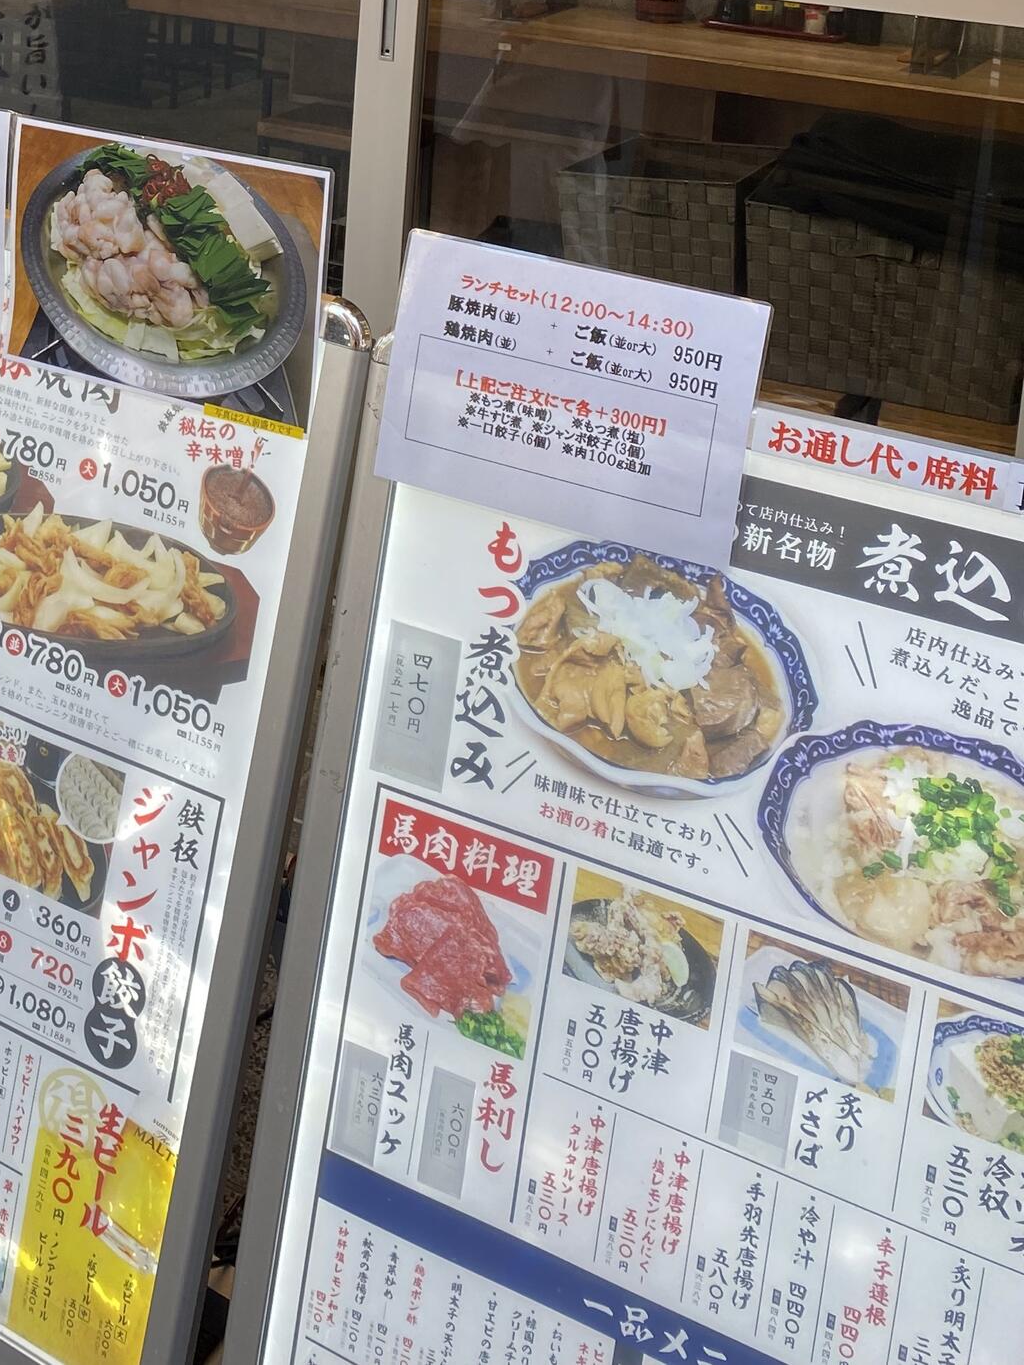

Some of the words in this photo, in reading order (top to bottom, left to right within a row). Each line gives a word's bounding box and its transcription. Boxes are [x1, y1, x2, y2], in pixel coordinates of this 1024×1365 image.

[444, 320, 517, 352] 鶏焼肉(並)
[570, 350, 653, 384] ご飯(並or大)
[669, 371, 718, 400] 950円
[447, 294, 521, 326] 豚焼肉(並)
[574, 324, 657, 357] ご飯(並or大)
[673, 345, 723, 372] 950円
[178, 417, 236, 440] 秘伝の
[465, 403, 522, 430] ※牛すじ煮
[0, 429, 66, 472] 780円
[81, 459, 96, 479] 大
[102, 462, 189, 514] 1,050円
[561, 442, 652, 477] ※肉100g追加
[768, 421, 998, 500] お通し代・席料
[741, 522, 836, 570] 新名物
[856, 523, 1012, 622] 煮込
[28, 636, 96, 687] 780円
[108, 675, 126, 697] 大
[130, 677, 225, 738] 1,050円
[407, 652, 433, 734] 四七〇円
[450, 522, 523, 790] もつ煮込み
[171, 800, 206, 870] 鉄板
[385, 812, 544, 900] 馬肉料理
[36, 905, 91, 949] 360円
[7, 984, 76, 1035] 1,080円
[30, 947, 83, 993] 720円
[581, 1004, 607, 1083] 五〇〇円
[609, 1007, 645, 1093] 唐揚げ
[641, 1019, 674, 1076] 中津
[7, 1052, 35, 1159] ホッピー・ハイサワー
[379, 1023, 416, 1155] 馬肉ユッケ
[475, 1061, 517, 1173] 馬刺し
[761, 1074, 778, 1126] 四五〇円
[794, 1087, 828, 1170] 〆さば
[836, 1092, 863, 1152] 炙り
[45, 1109, 89, 1230] 三九〇円
[78, 1096, 128, 1243] 生ビール
[557, 1124, 581, 1228] タルタルソース
[577, 1115, 606, 1217] 中津唐揚げ
[661, 1150, 691, 1255] 中津唐揚げ
[943, 1145, 973, 1236] 五三〇円
[977, 1155, 1015, 1220] 冷奴
[34, 1231, 48, 1266] ビール
[354, 1238, 375, 1305] 軟骨の唐揚げ
[384, 1251, 399, 1300] 青菜炒め
[618, 1209, 638, 1273] 五三〇円
[732, 1182, 766, 1311] 手羽先唐揚げ
[794, 1205, 821, 1271] 冷や汁
[37, 1237, 61, 1324] ノンアルコール
[406, 1264, 426, 1327] 鶏皮ポン酢
[708, 1247, 730, 1315] 五八〇円
[784, 1281, 807, 1350] 四四〇円
[865, 1236, 896, 1327] 辛子蓮根
